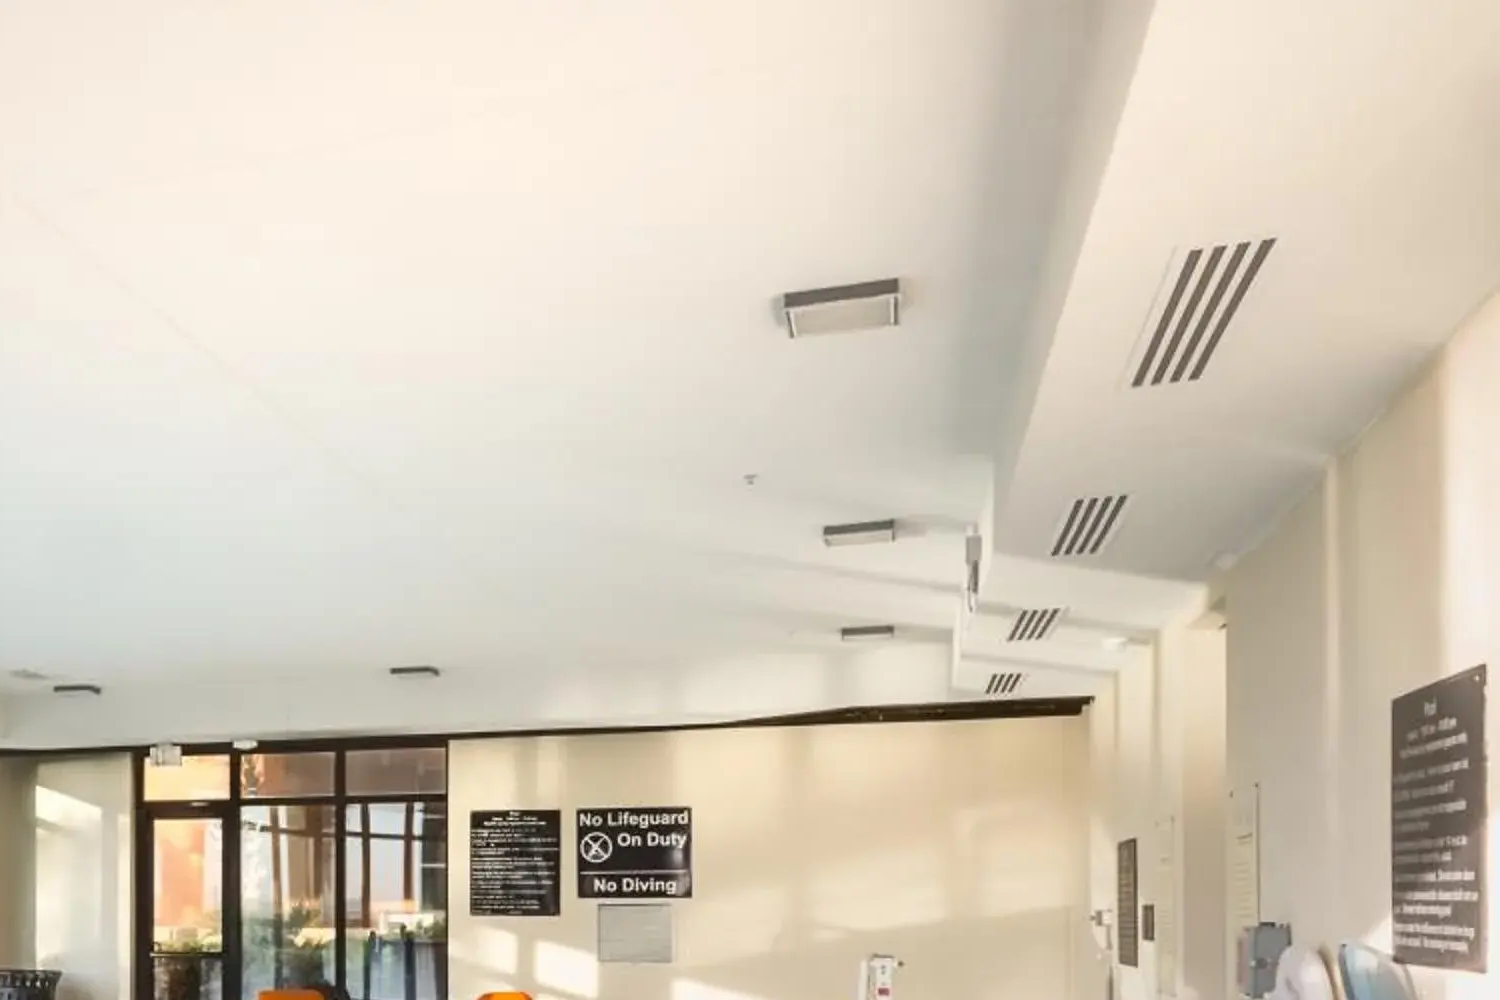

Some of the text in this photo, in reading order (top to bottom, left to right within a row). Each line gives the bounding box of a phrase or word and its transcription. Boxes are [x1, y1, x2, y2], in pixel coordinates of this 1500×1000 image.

[579, 810, 689, 828] No Lifeguard
[617, 832, 687, 849] On Duty
[593, 878, 677, 894] No Diving
